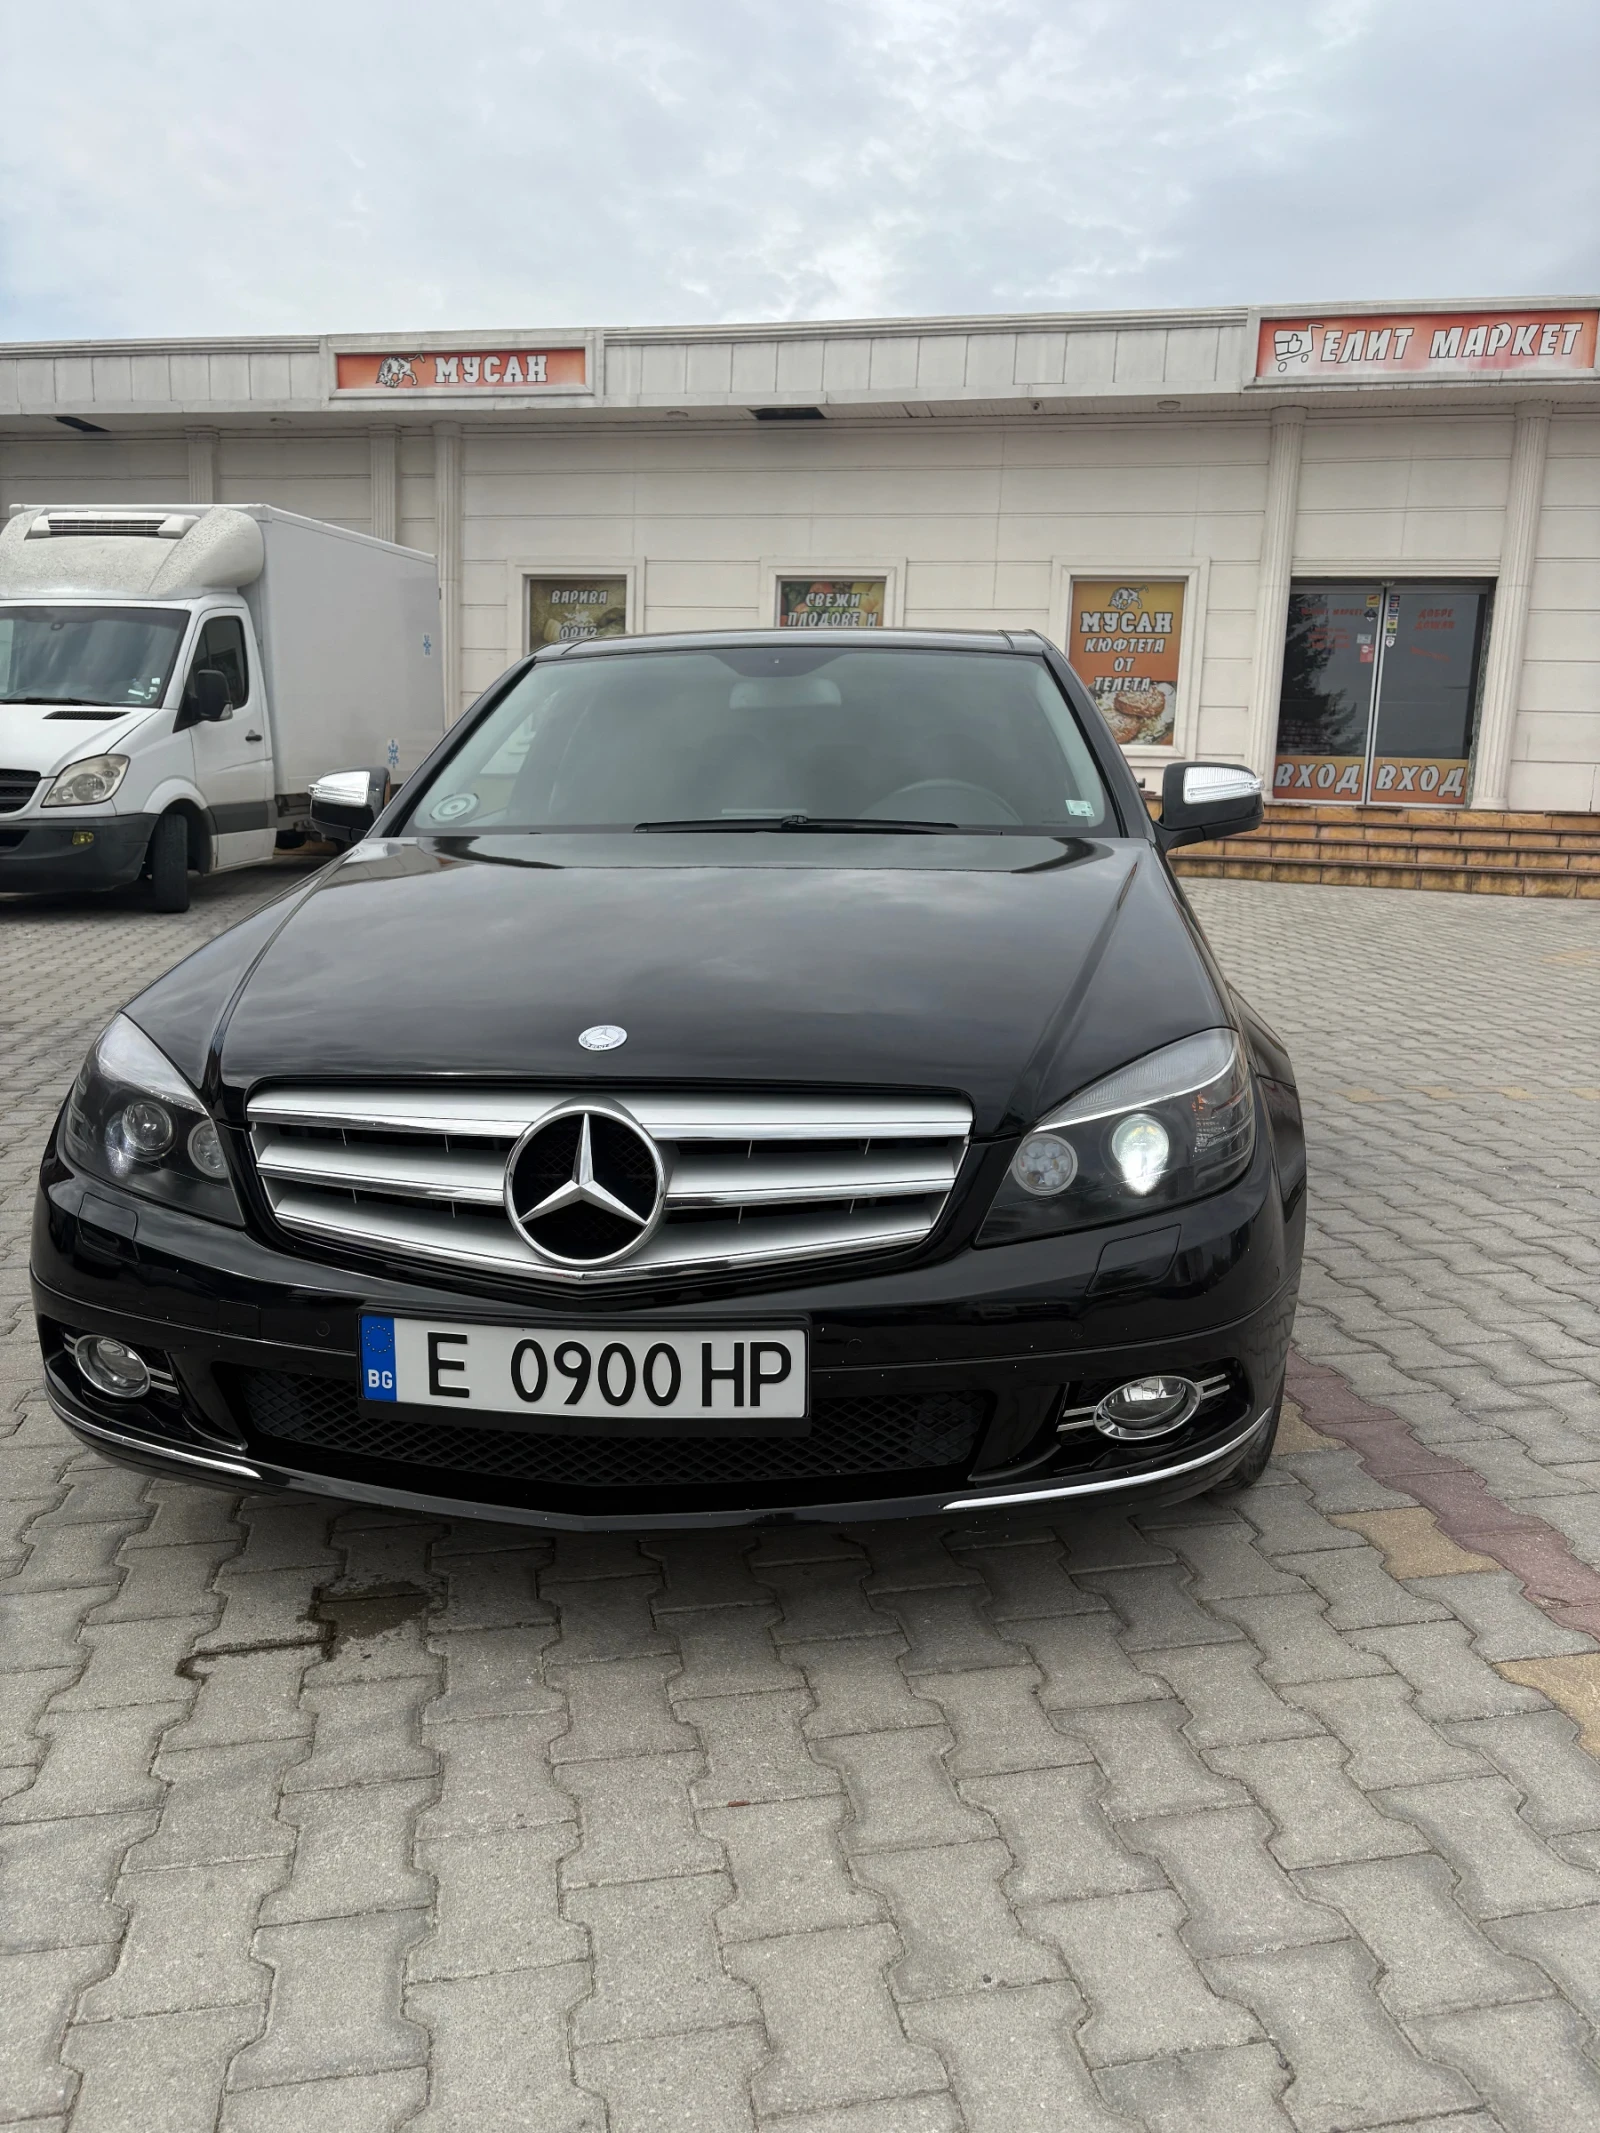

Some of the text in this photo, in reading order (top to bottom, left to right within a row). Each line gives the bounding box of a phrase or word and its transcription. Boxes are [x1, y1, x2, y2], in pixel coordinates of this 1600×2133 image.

[1321, 322, 1583, 363] ЕЛИТ МАРКЕТ
[434, 355, 548, 384] МУСАН
[550, 590, 608, 604] ВАРИВА
[805, 592, 861, 608] СВЕЖИ
[786, 611, 879, 627] ПЛОДОВЕ И
[1080, 611, 1173, 634] МУСАН
[1084, 638, 1165, 654] КЮФТЕТА
[1113, 657, 1136, 672] ОТ
[1094, 676, 1152, 692] ТЕЛЕТА
[1273, 762, 1361, 794] ВХОД
[1374, 764, 1466, 797] ВХОД
[367, 1369, 393, 1389] BG
[428, 1331, 791, 1407] E 0900 HP
